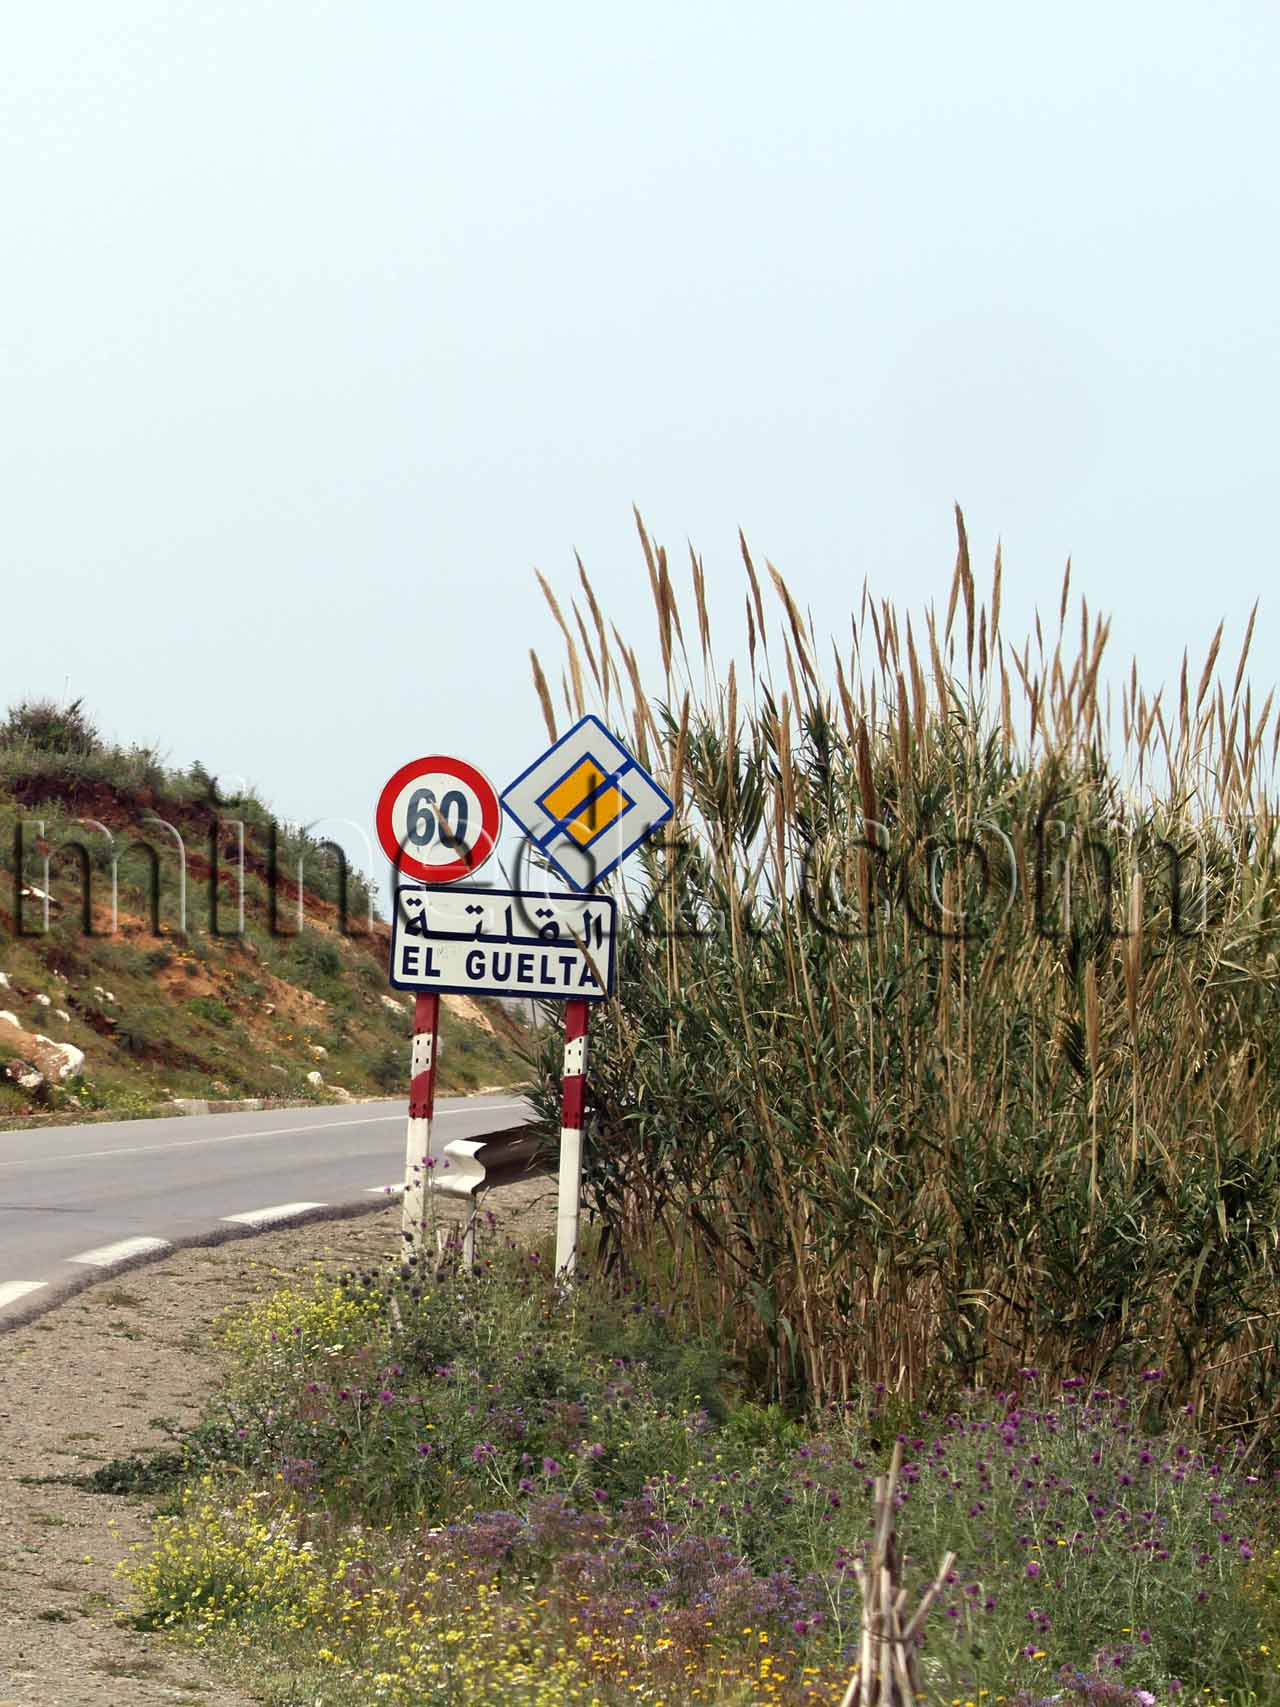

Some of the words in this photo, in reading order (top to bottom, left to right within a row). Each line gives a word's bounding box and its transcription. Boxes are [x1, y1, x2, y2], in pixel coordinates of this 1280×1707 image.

[406, 788, 469, 849] 60
[405, 897, 602, 950] القلتة
[401, 945, 441, 978] EL
[465, 949, 600, 988] GUELTA
